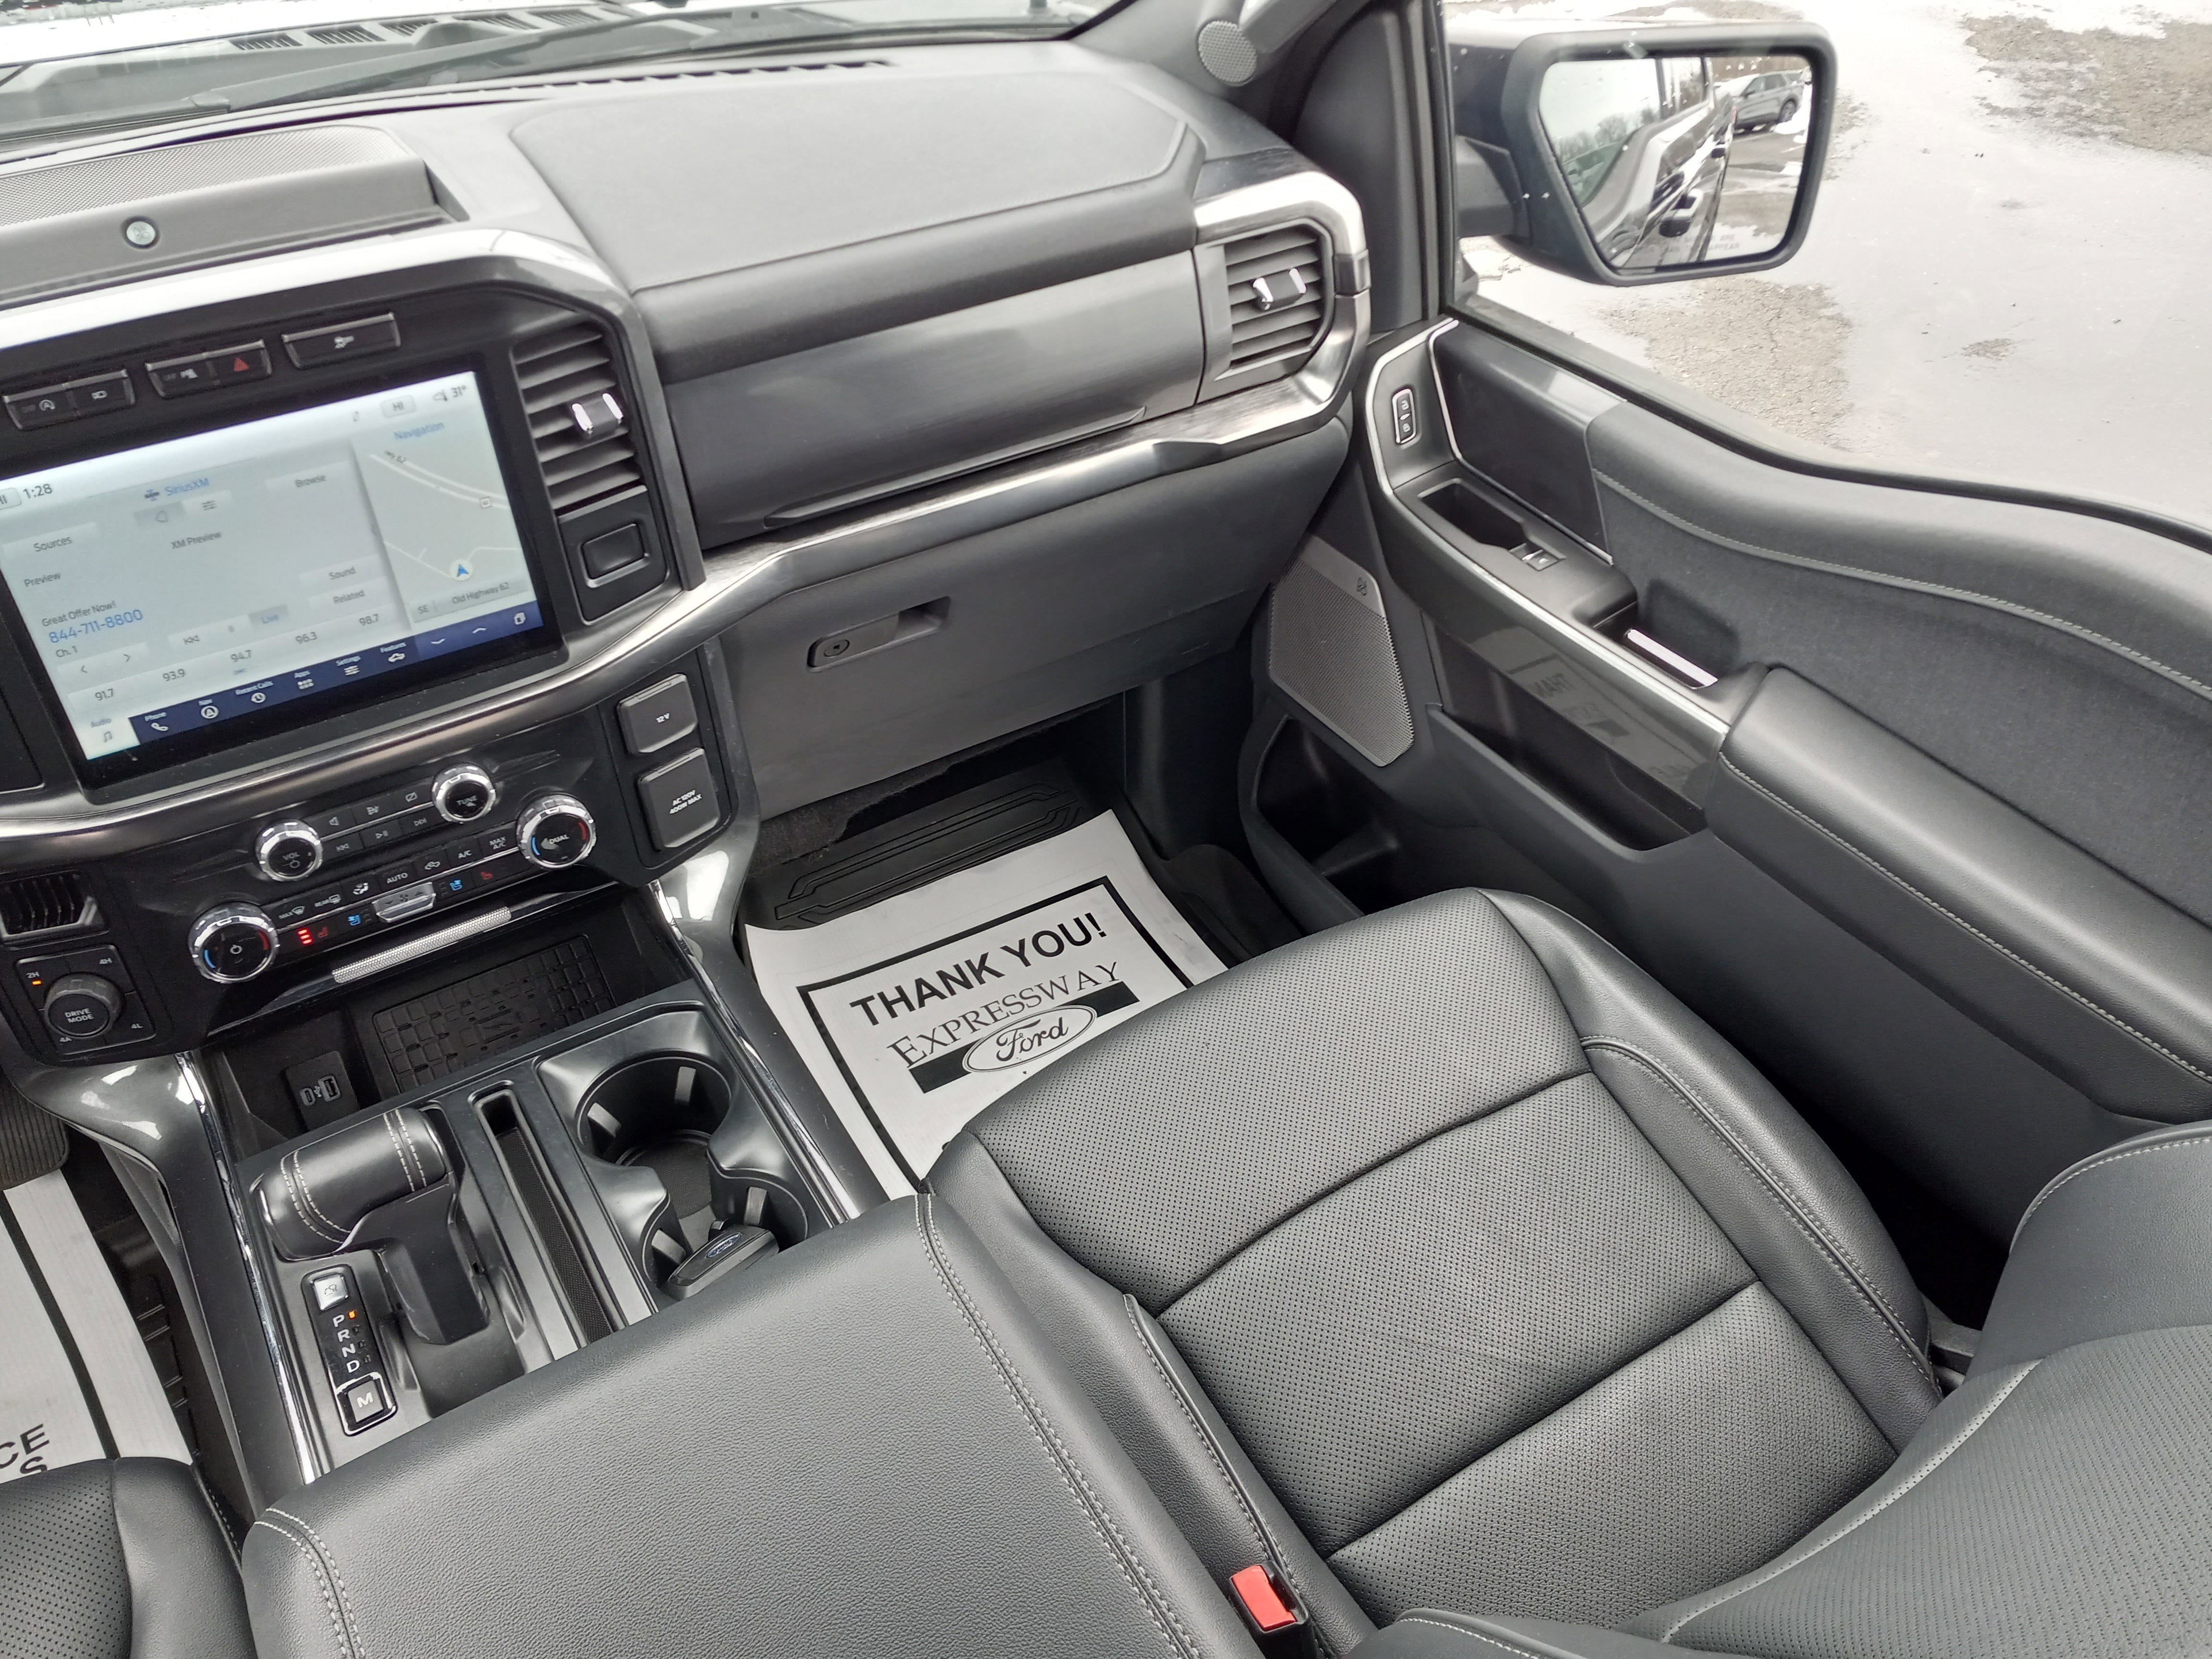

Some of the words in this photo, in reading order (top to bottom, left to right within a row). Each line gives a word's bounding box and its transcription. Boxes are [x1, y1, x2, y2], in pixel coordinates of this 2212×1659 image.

[23, 483, 53, 499] 1:28
[164, 478, 210, 495] SiriusXM
[34, 537, 72, 552] Sources
[170, 539, 187, 549] XM
[186, 531, 222, 545] Preview
[328, 567, 356, 580] Sound
[24, 573, 61, 588] Preview
[333, 589, 365, 604] Related
[452, 594, 466, 604] Old
[466, 586, 499, 599] Highway
[499, 581, 510, 591] 62
[42, 613, 68, 626] Great
[68, 608, 91, 619] Offer
[92, 601, 117, 613] Now!
[418, 605, 429, 614] SE
[48, 609, 143, 643] 844-711-8800
[359, 613, 378, 626] 98.7
[295, 632, 317, 644] 96.3
[56, 647, 71, 658] Ch.
[72, 645, 78, 653] 1
[336, 655, 361, 666] Settings
[162, 669, 186, 681] 93.9
[95, 688, 114, 701] 91.7
[91, 717, 112, 728] Audio
[144, 711, 168, 722] Phone
[655, 713, 670, 723] 12V
[456, 795, 478, 806] TUNE
[673, 797, 682, 806] AC
[681, 790, 696, 801] 120V
[687, 793, 702, 805] MAX
[489, 836, 506, 845] MAX
[549, 833, 570, 844] DUAL
[493, 842, 506, 851] A/C
[282, 852, 301, 861] VOL
[457, 849, 472, 859] A/C
[386, 872, 408, 884] AUTO
[850, 951, 1005, 1025] THANK
[1000, 912, 1107, 968] YOU!
[65, 1008, 91, 1018] DRIVE
[67, 1013, 95, 1023] MODE
[887, 961, 1123, 1069] EXPRESSWAY
[995, 1016, 1070, 1063] Ford
[333, 1314, 345, 1328] P
[337, 1329, 350, 1343] R
[341, 1343, 356, 1358] N
[346, 1360, 360, 1373] D
[357, 1392, 374, 1408] M
